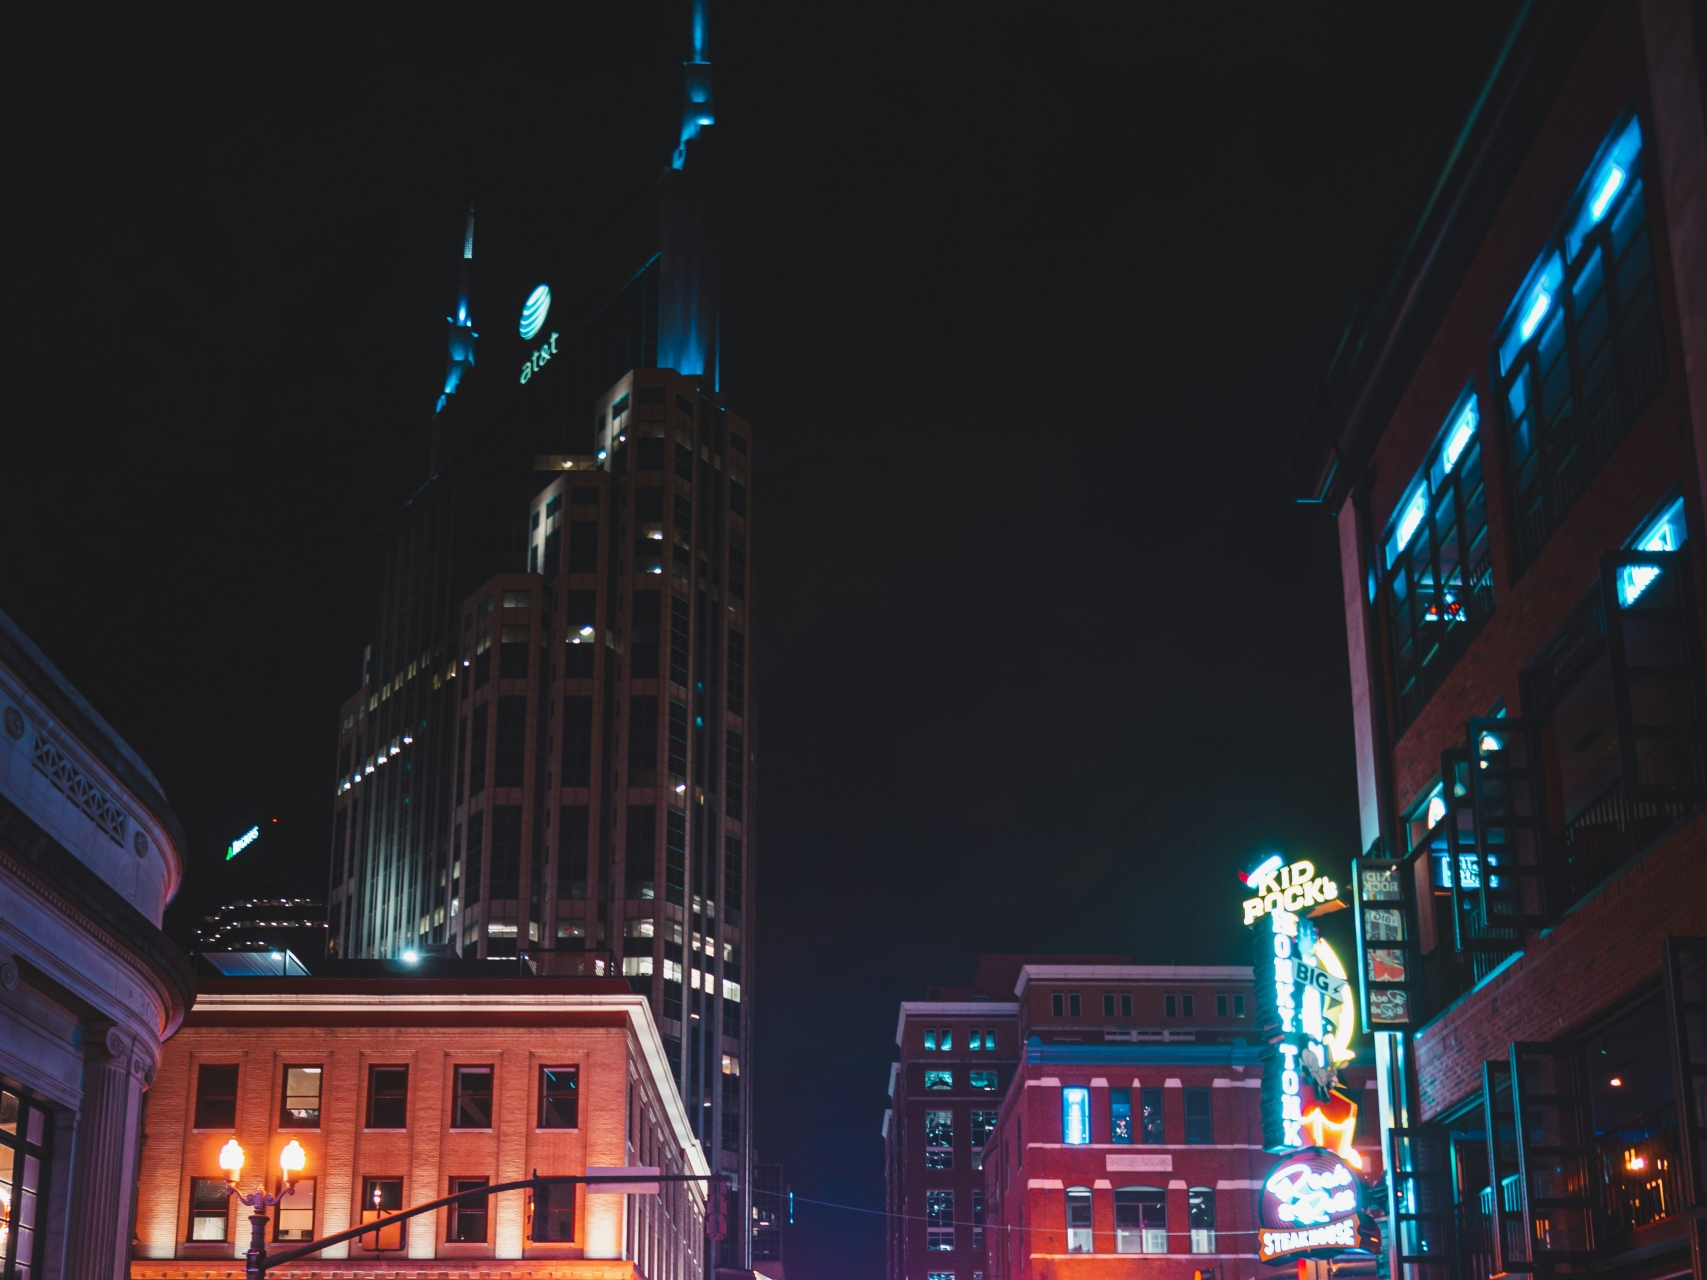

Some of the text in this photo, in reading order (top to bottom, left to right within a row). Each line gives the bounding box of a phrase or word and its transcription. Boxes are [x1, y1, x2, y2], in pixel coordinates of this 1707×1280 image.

[519, 331, 559, 384] at&t
[1257, 860, 1315, 896] KID
[1296, 962, 1331, 993] BIG
[1279, 1043, 1302, 1147] TONK
[1263, 1218, 1355, 1256] STEAKHOUSE
